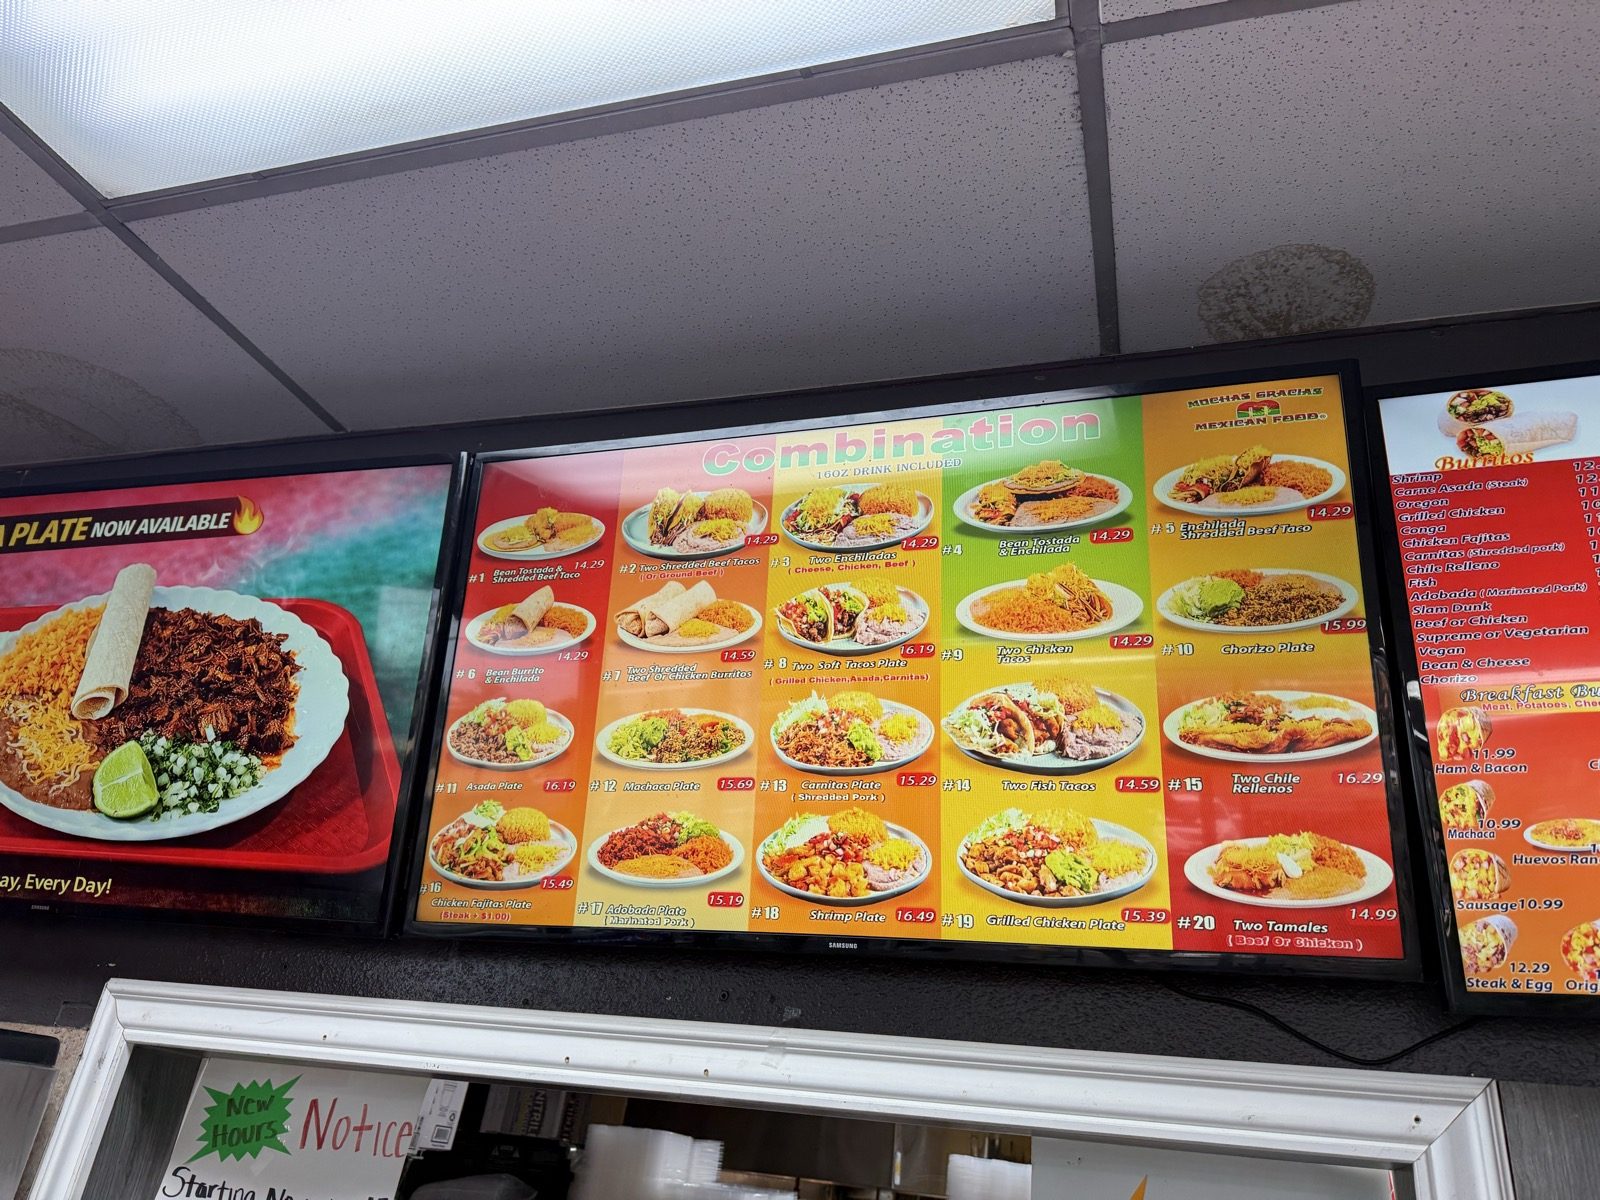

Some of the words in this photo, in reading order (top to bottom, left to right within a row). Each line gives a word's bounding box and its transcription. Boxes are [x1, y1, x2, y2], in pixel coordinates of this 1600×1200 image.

[1194, 418, 1267, 431] MEXICAN
[703, 411, 1101, 477] Combination
[854, 465, 892, 476] DRINK
[896, 458, 962, 472] INCLUDED
[1434, 451, 1534, 471] Burritos
[1392, 474, 1442, 484] Shrimp
[1395, 487, 1436, 496] Carne
[1438, 481, 1482, 493] Asada
[1396, 498, 1449, 509] Oregon
[1309, 506, 1352, 517] 14.29
[1399, 510, 1446, 522] Grilled
[1449, 507, 1504, 518] Chicken
[8, 516, 92, 547] PLATE
[90, 518, 136, 539] NOW
[134, 512, 232, 536] AVAILABLE
[1180, 519, 1246, 532] Enchilada
[1401, 525, 1446, 534] Conga
[1092, 530, 1131, 541] 14.29
[1180, 528, 1244, 540] Shredded
[1248, 526, 1278, 536] Beef
[1280, 524, 1312, 534] Taco
[746, 536, 778, 546] 14.29
[902, 538, 938, 549] 14.29
[999, 540, 1030, 550] Bean
[1032, 536, 1080, 546] Tostada
[1403, 537, 1458, 548] Chicken
[1462, 532, 1510, 544] Fajitas
[1011, 544, 1070, 556] Enchilada
[1404, 550, 1464, 560] Carnitas
[809, 556, 831, 564] Two
[834, 552, 896, 563] Enchiladas
[574, 560, 604, 570] 14.29
[660, 560, 708, 571] Shredded
[708, 558, 732, 568] Beef
[733, 558, 760, 566] Tacos
[1406, 564, 1442, 574] Chile
[1445, 561, 1499, 572] Relleno
[492, 573, 534, 584] Shredded
[537, 572, 557, 581] Beef
[560, 571, 580, 579] Taco
[493, 569, 516, 577] Bean
[519, 566, 553, 575] Tostada
[1408, 579, 1437, 588] Fish
[1410, 590, 1476, 600] Adobada
[1412, 605, 1448, 614] Slam
[1452, 602, 1492, 612] Dunk
[1324, 620, 1367, 631] 15.99
[1415, 618, 1447, 628] Beef
[1469, 614, 1528, 625] Chicken
[1416, 631, 1481, 643] Supreme
[1504, 626, 1588, 638] Vegetarian
[1112, 636, 1152, 646] 14.29
[900, 645, 934, 655] 16.19
[997, 646, 1021, 656] Two
[1024, 644, 1074, 654] Chicken
[1221, 644, 1275, 654] Chorizo
[1278, 643, 1315, 652] Plate
[1419, 646, 1465, 656] Vegan
[558, 652, 588, 661] 14.29
[723, 650, 756, 660] 14.59
[996, 655, 1031, 664] Tacos
[627, 666, 646, 674] Two
[650, 664, 697, 674] Shredded
[792, 662, 814, 671] Two
[818, 660, 840, 670] Soft
[846, 660, 875, 668] Tacos
[878, 658, 907, 668] Plate
[1422, 662, 1458, 670] Bean
[1477, 658, 1530, 667] Cheese
[512, 667, 544, 675] Burrito
[627, 674, 650, 682] Beef
[668, 672, 708, 681] Chicken
[710, 670, 752, 679] Burritos
[494, 675, 540, 684] Enchilada
[1420, 675, 1478, 684] Chorizo
[1460, 684, 1564, 704] Breakfast
[1472, 748, 1516, 760] 11.99
[1435, 764, 1466, 774] Ham
[1484, 762, 1528, 774] Bacon
[900, 776, 937, 786] 15.29
[1232, 774, 1261, 784] Two
[1264, 774, 1300, 784] Chile
[1337, 773, 1383, 784] 16.29
[466, 781, 496, 790] Asada
[498, 782, 522, 790] Plate
[545, 781, 576, 791] 16.19
[624, 782, 670, 792] Machaca
[672, 782, 700, 791] Plate
[720, 780, 754, 790] 15.69
[801, 780, 848, 790] Carnitas
[850, 780, 880, 790] Plate
[1002, 781, 1028, 790] Two
[1030, 781, 1056, 790] Fish
[1060, 782, 1096, 792] Tacos
[1118, 779, 1160, 790] 14.59
[1232, 784, 1294, 794] Rellenos
[1478, 818, 1521, 829] 10.99
[1448, 829, 1496, 839] Machaca
[1513, 854, 1566, 865] Huevos
[24, 874, 71, 896] Every
[73, 876, 112, 898] Day!
[542, 880, 574, 890] 15.49
[432, 898, 468, 908] Chicken
[471, 900, 503, 910] Fajitas
[506, 901, 532, 909] Plate
[709, 895, 744, 905] 15.19
[1456, 900, 1518, 912] Sausage
[1519, 899, 1563, 910] 10.99
[606, 904, 656, 916] Adobada
[657, 906, 686, 916] Plate
[810, 910, 852, 922] Shrimp
[854, 911, 886, 922] Plate
[896, 910, 935, 922] 16.49
[1123, 910, 1166, 922] 15.39
[1350, 908, 1397, 920] 14.99
[986, 915, 1030, 927] Grilled
[1033, 916, 1087, 929] Chicken
[1089, 918, 1125, 930] Plate
[1234, 920, 1263, 930] Two
[1266, 920, 1328, 933] Tamales
[1510, 962, 1550, 973] 12.29
[1466, 978, 1507, 988] Steak
[1526, 979, 1553, 992] Egg
[300, 1097, 414, 1158] Notice
